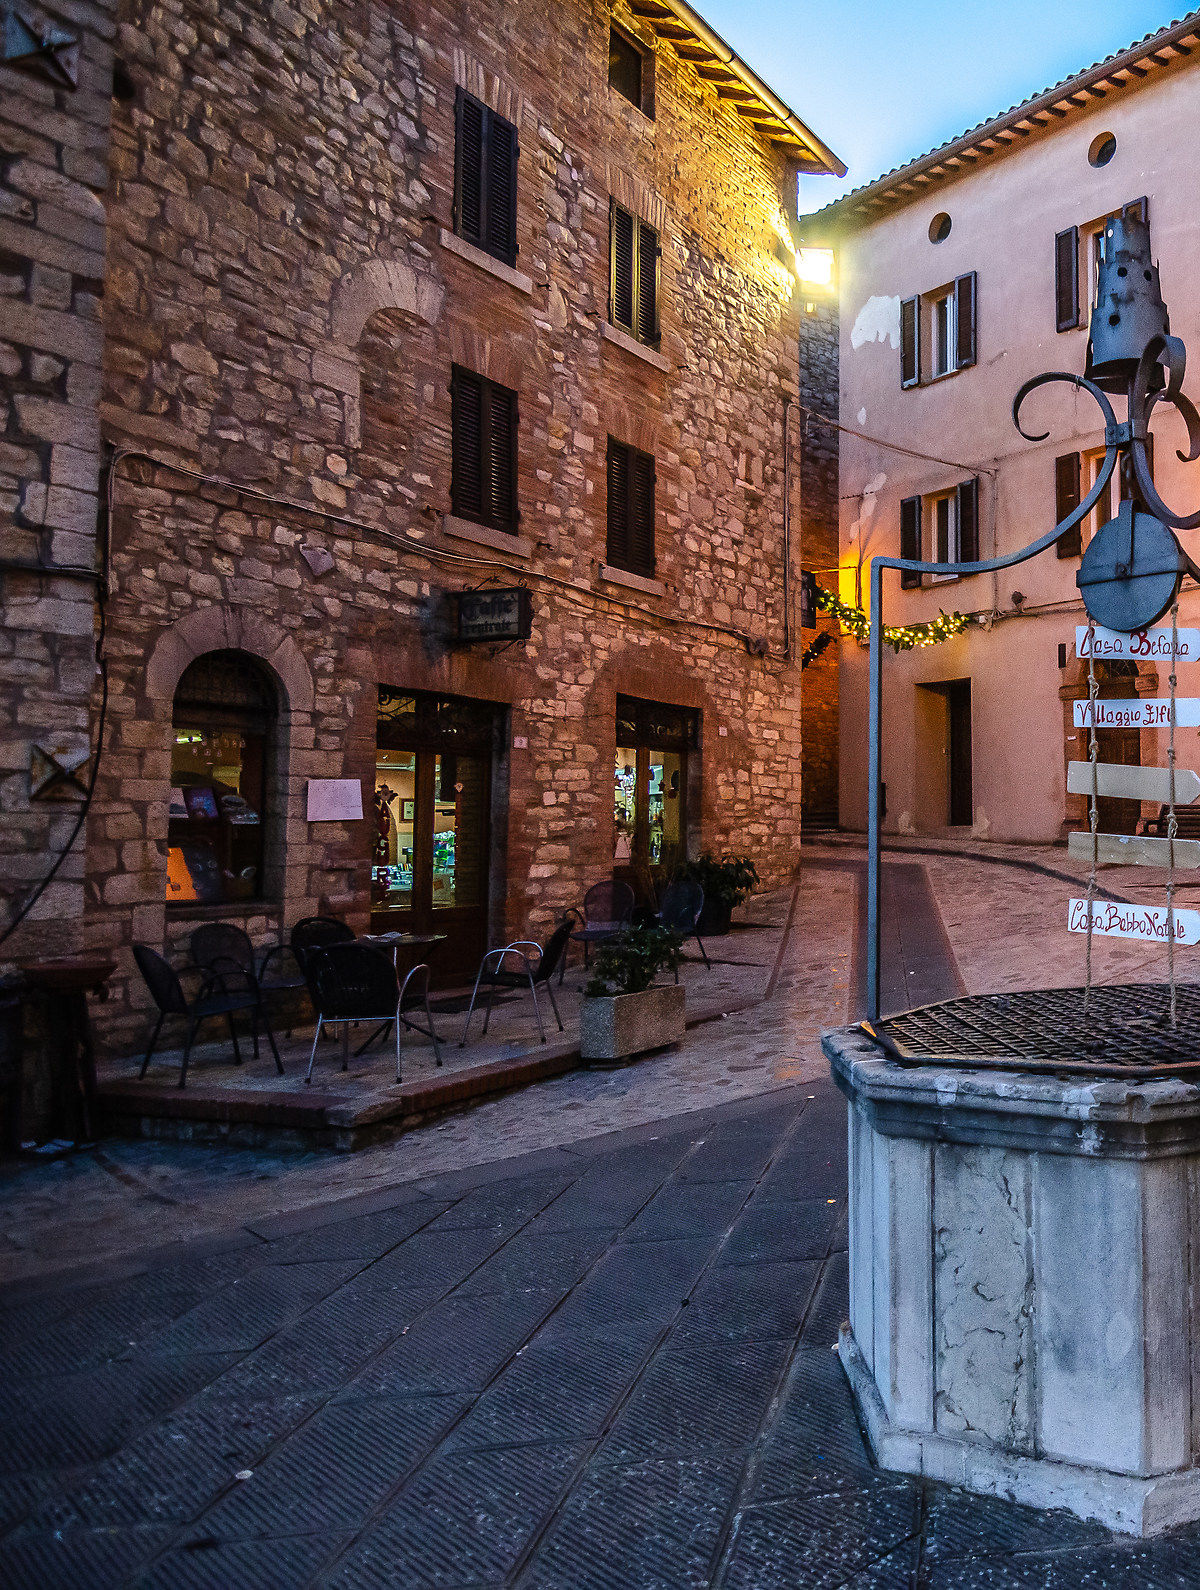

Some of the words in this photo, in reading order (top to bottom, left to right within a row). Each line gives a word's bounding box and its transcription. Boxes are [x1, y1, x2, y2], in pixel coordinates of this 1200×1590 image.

[1080, 627, 1123, 656] Casa
[1077, 702, 1140, 727] Vllaggio
[1142, 704, 1171, 725] Elfi
